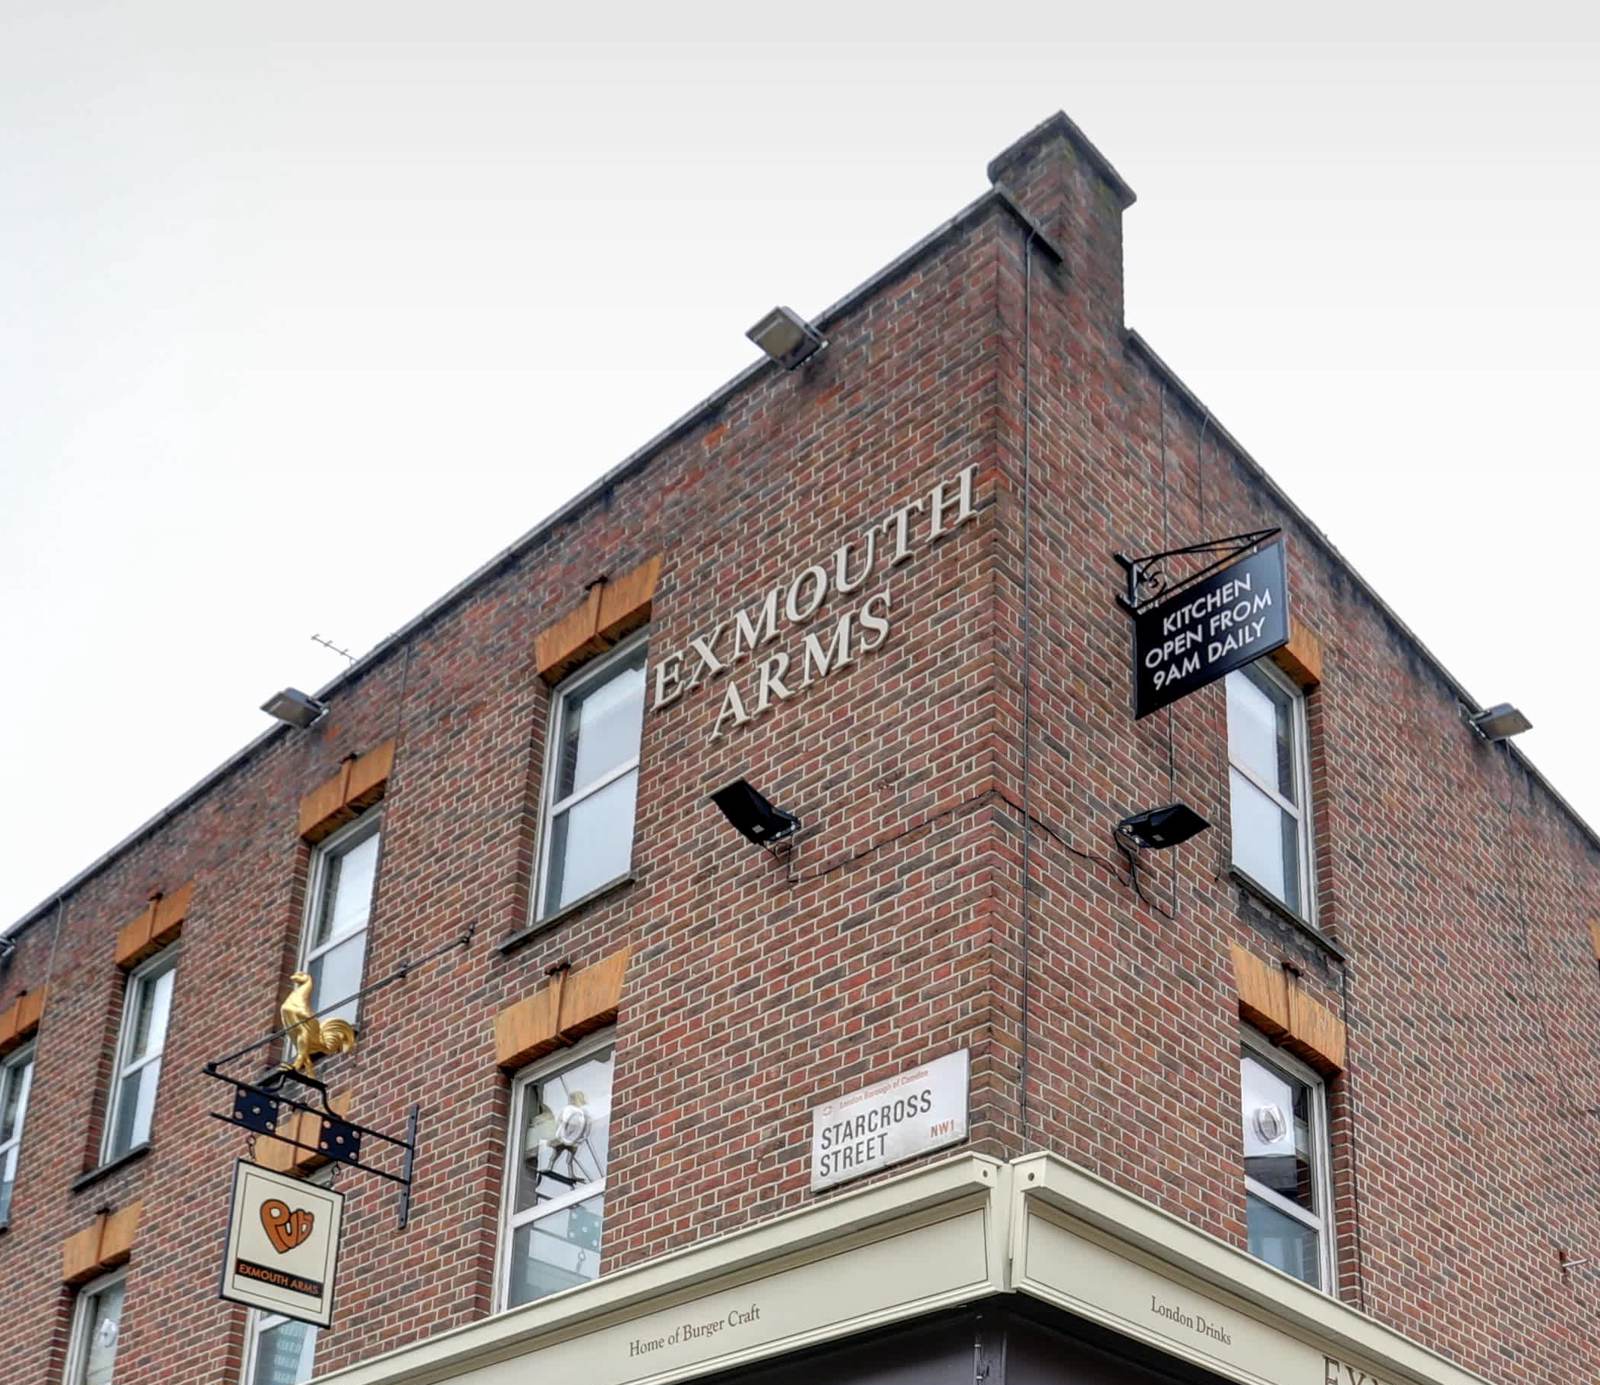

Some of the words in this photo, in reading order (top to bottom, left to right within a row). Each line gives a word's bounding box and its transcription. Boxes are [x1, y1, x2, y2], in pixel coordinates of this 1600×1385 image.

[651, 462, 979, 713] EXMOUTH
[1163, 573, 1251, 636] KITCHEN
[1145, 625, 1203, 668] OPEN
[1210, 588, 1272, 637] FROM
[1153, 651, 1200, 690] 9AM
[1207, 617, 1266, 664] DAILY
[709, 588, 892, 743] ARMS
[820, 1133, 888, 1177] STREET
[930, 1119, 955, 1138] NW1
[821, 1089, 932, 1150] STARCROSS
[238, 1262, 290, 1287] EXMOUTH
[290, 1276, 319, 1295] ARMS
[629, 1339, 665, 1357] Home
[667, 1327, 681, 1346] of
[682, 1319, 725, 1343] Burger
[728, 1304, 761, 1328] Craft
[1151, 1295, 1193, 1329] London
[1196, 1315, 1232, 1346] Drinks
